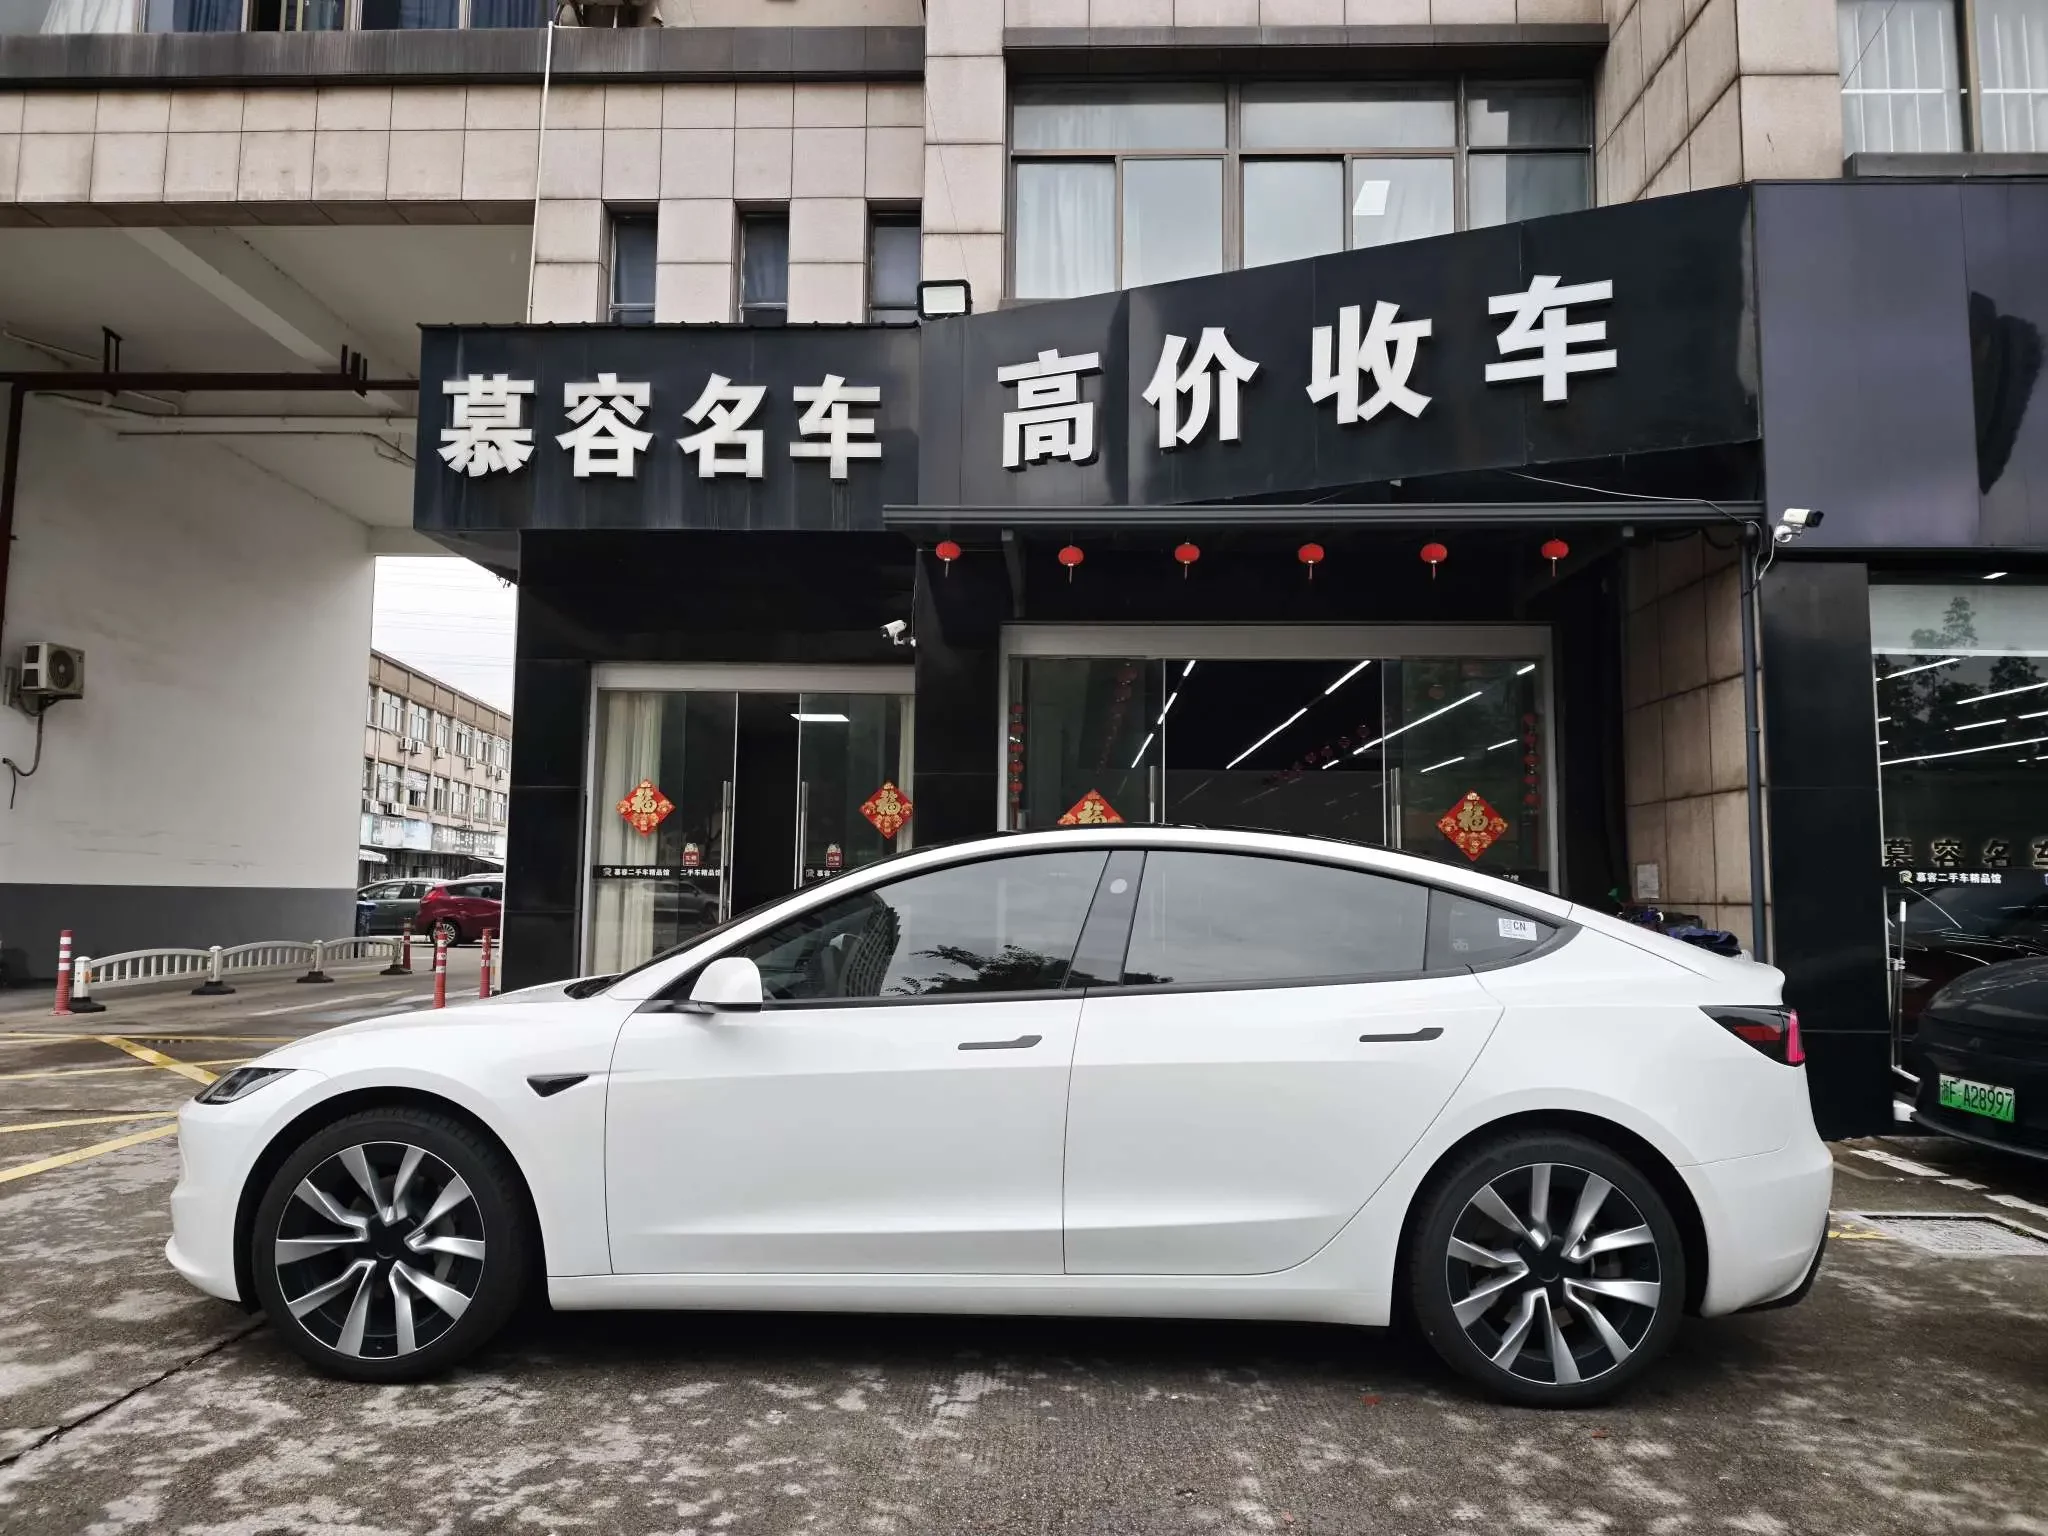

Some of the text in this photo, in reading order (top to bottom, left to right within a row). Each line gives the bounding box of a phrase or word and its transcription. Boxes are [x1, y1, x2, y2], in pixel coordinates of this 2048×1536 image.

[997, 274, 1617, 470] 高价收车
[436, 373, 882, 479] 慕容名车
[1457, 800, 1489, 832] 福
[1916, 872, 2002, 884] 慕容二手车精品馆
[1513, 921, 1526, 931] CN
[1963, 1083, 2012, 1117] A28997
